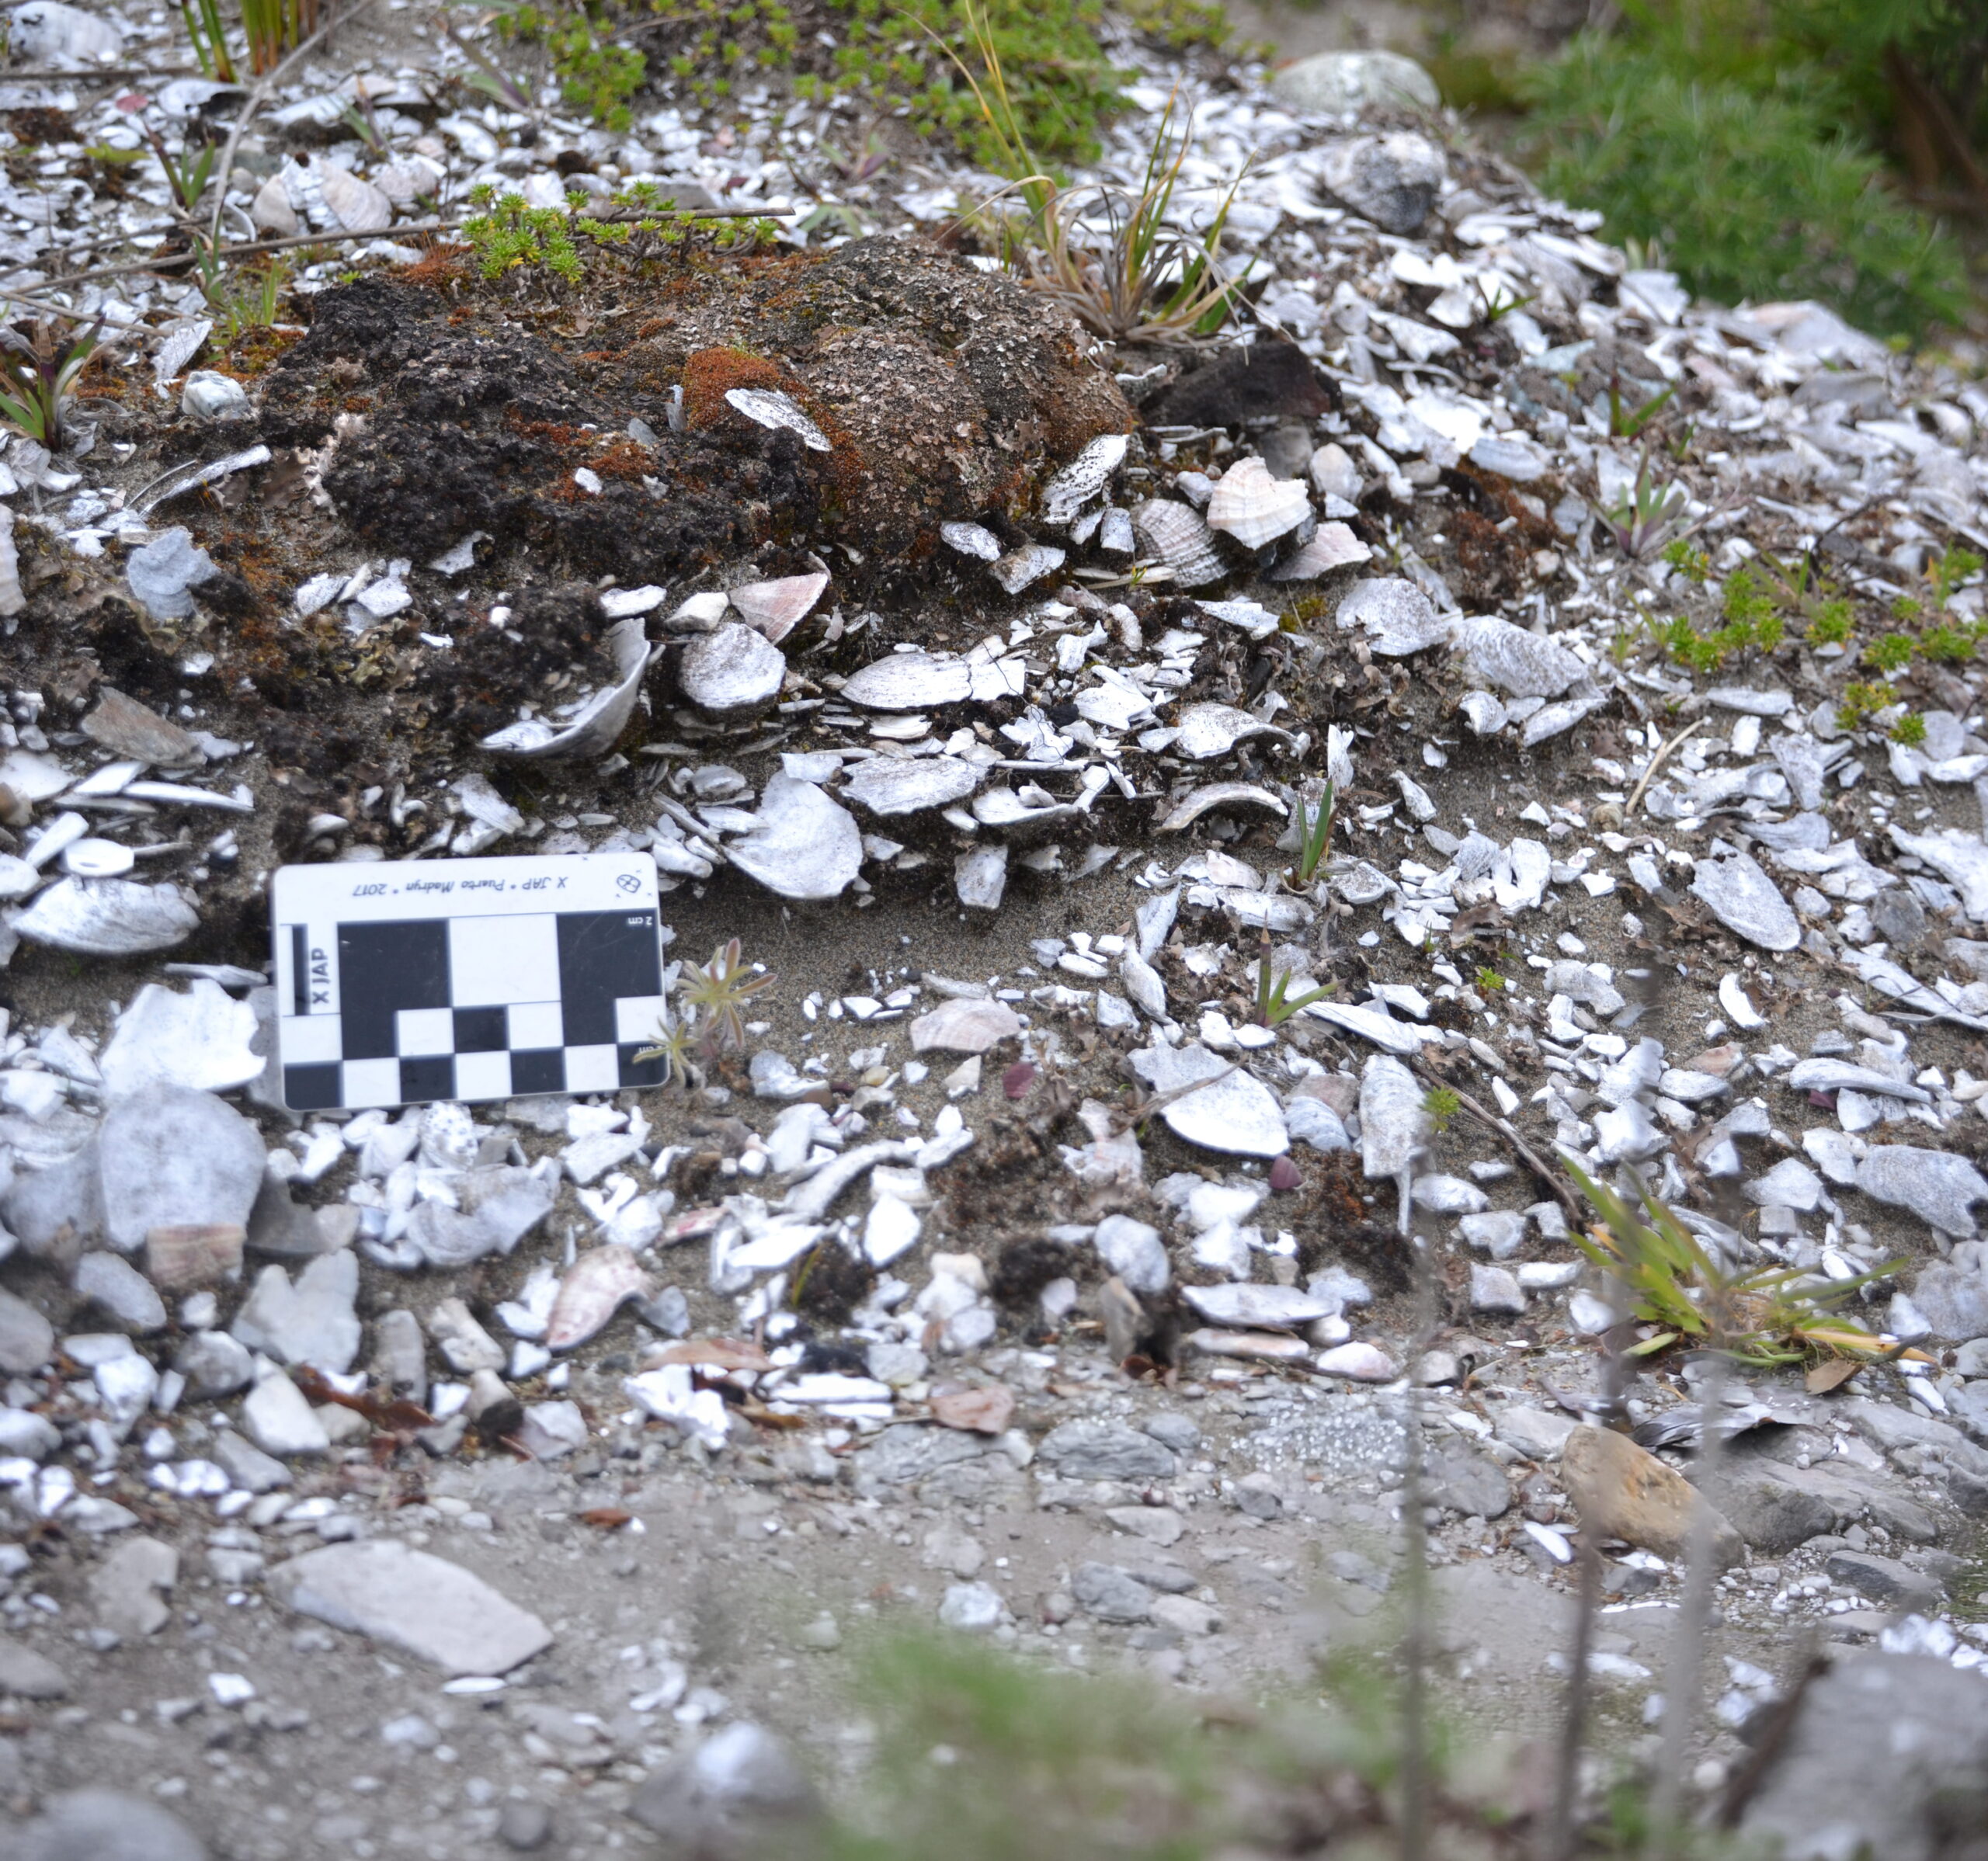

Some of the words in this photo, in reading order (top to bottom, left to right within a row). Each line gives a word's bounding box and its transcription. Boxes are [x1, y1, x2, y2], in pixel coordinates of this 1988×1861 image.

[405, 878, 455, 894] Madryn
[461, 878, 506, 891] Puerto
[521, 876, 552, 891] JAP
[557, 876, 569, 889] X
[352, 883, 388, 897] 2017
[645, 916, 653, 925] 2
[311, 947, 331, 984] JAP
[311, 990, 330, 1005] X
